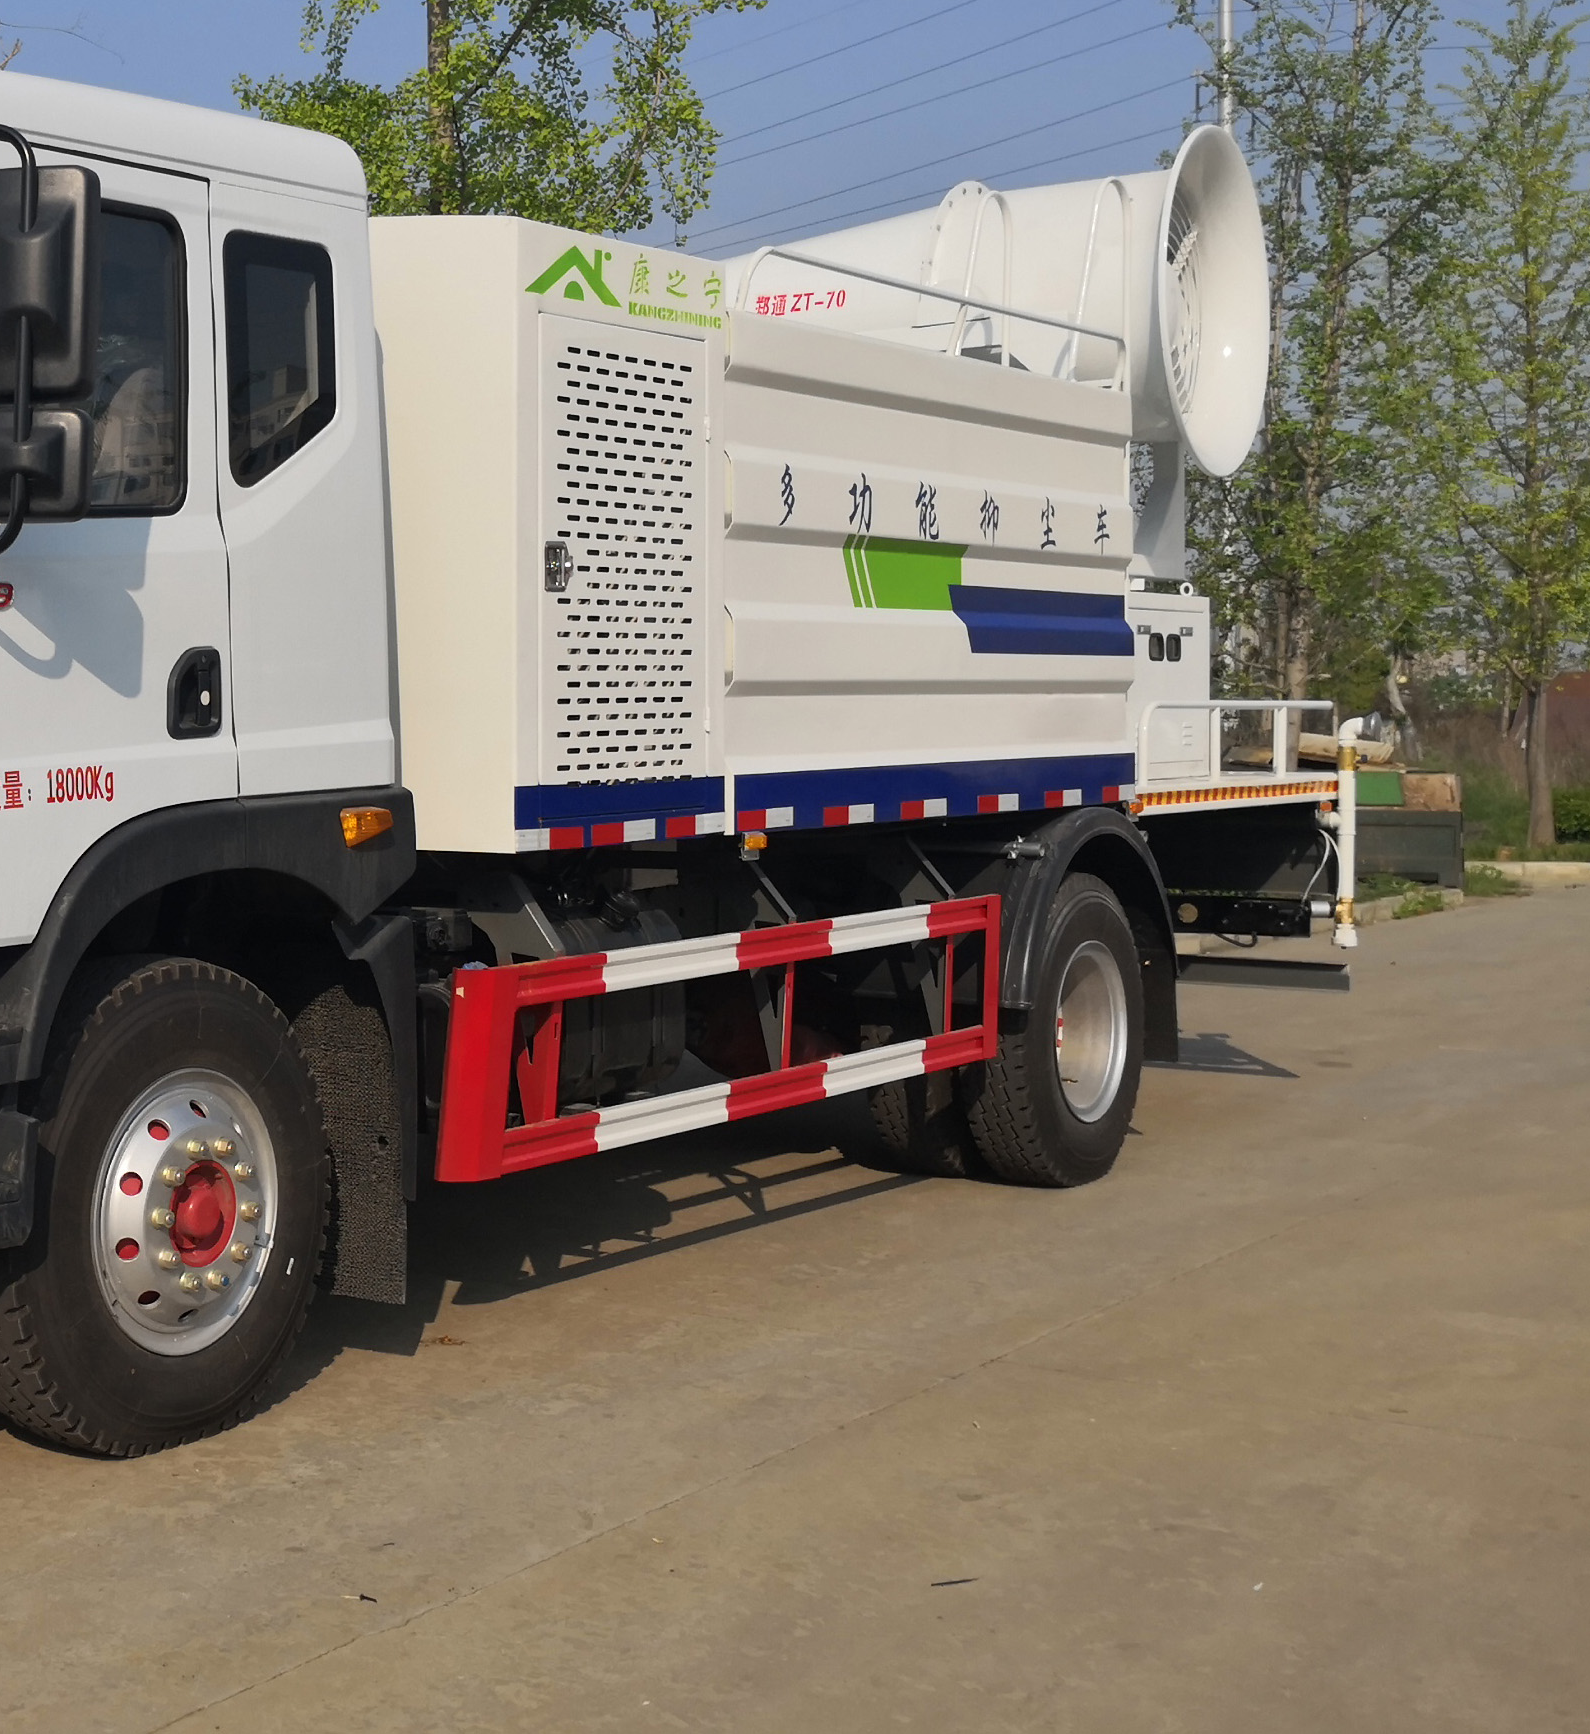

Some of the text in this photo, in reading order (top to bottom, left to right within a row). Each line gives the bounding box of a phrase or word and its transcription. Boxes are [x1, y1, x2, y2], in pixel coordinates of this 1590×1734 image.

[628, 252, 722, 310] 康之宁
[790, 288, 847, 313] ZT-70
[778, 463, 1110, 556] 多功能抑尘车
[46, 765, 115, 804] 18000Kg
